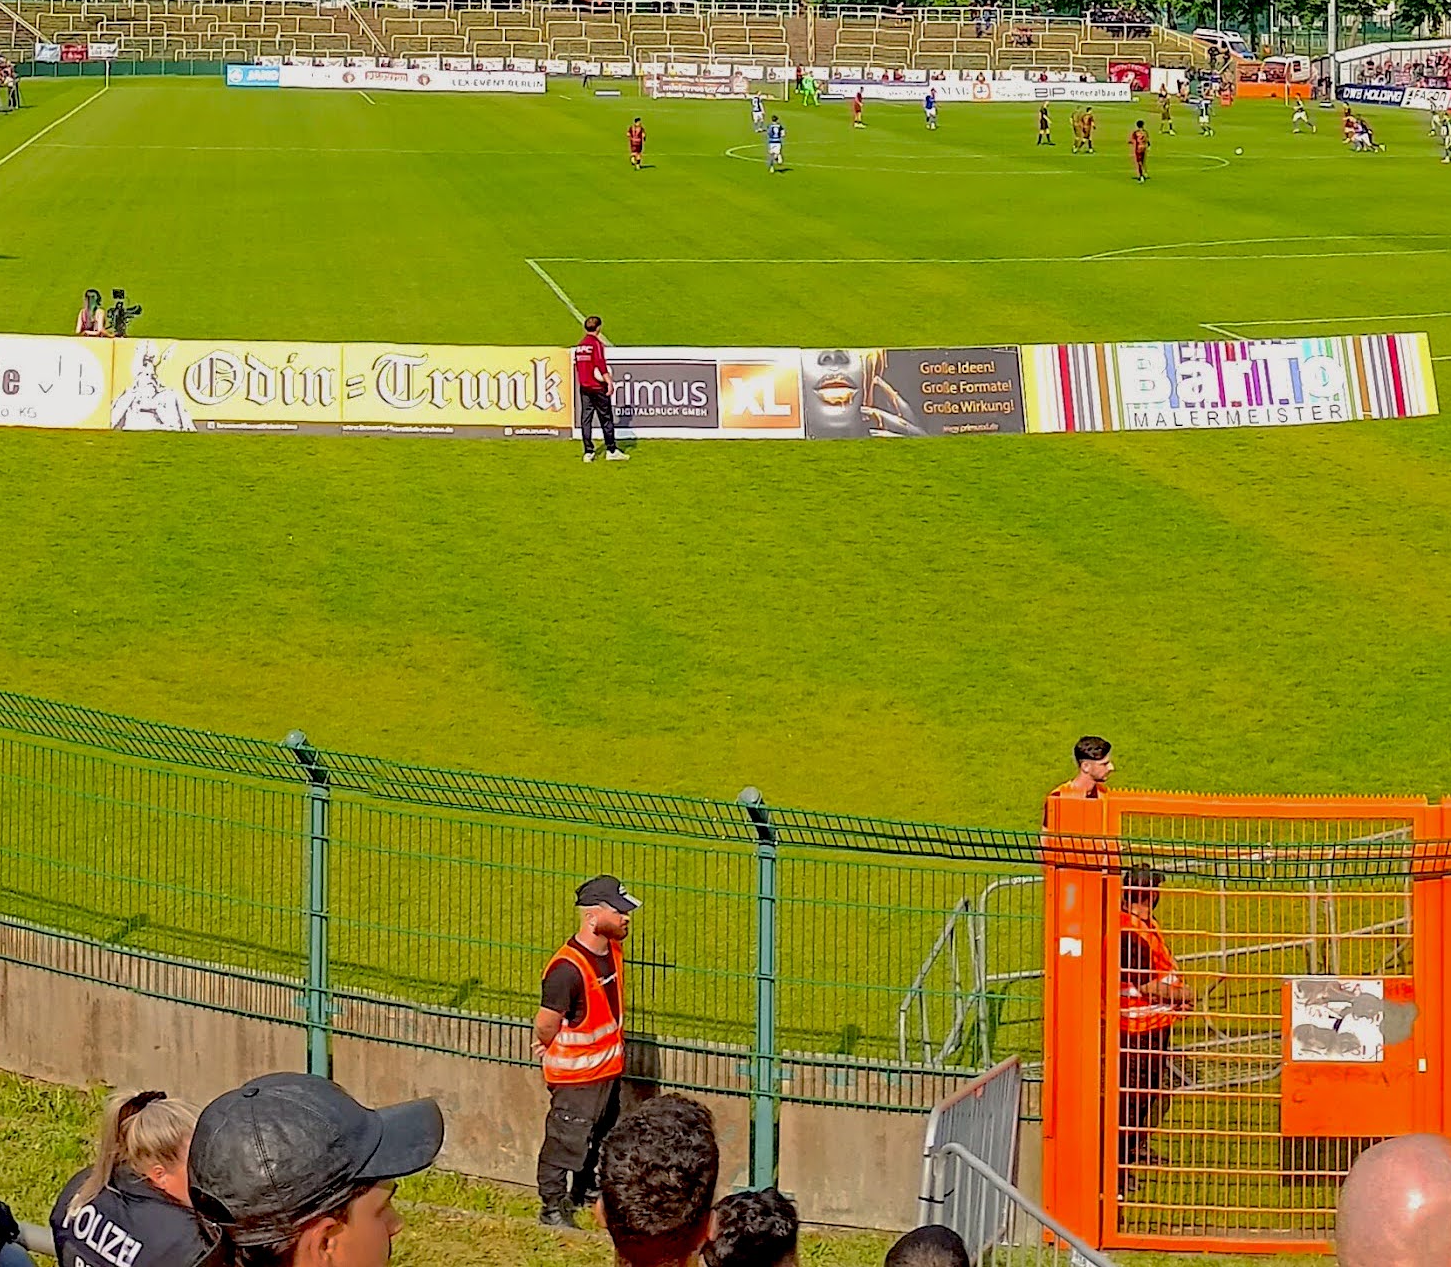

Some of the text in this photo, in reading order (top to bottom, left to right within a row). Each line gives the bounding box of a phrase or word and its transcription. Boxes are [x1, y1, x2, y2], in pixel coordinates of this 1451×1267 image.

[919, 360, 996, 375] Große Ideen!
[612, 372, 708, 407] rimus
[726, 375, 793, 417] XL
[921, 379, 1013, 394] Große Formate!
[614, 406, 708, 418] DIGITALDRUCK GMBH
[922, 399, 1015, 415] Große Wirkung!
[1133, 404, 1344, 428] MALERMEISTER
[61, 1203, 143, 1267] POLIZEI
